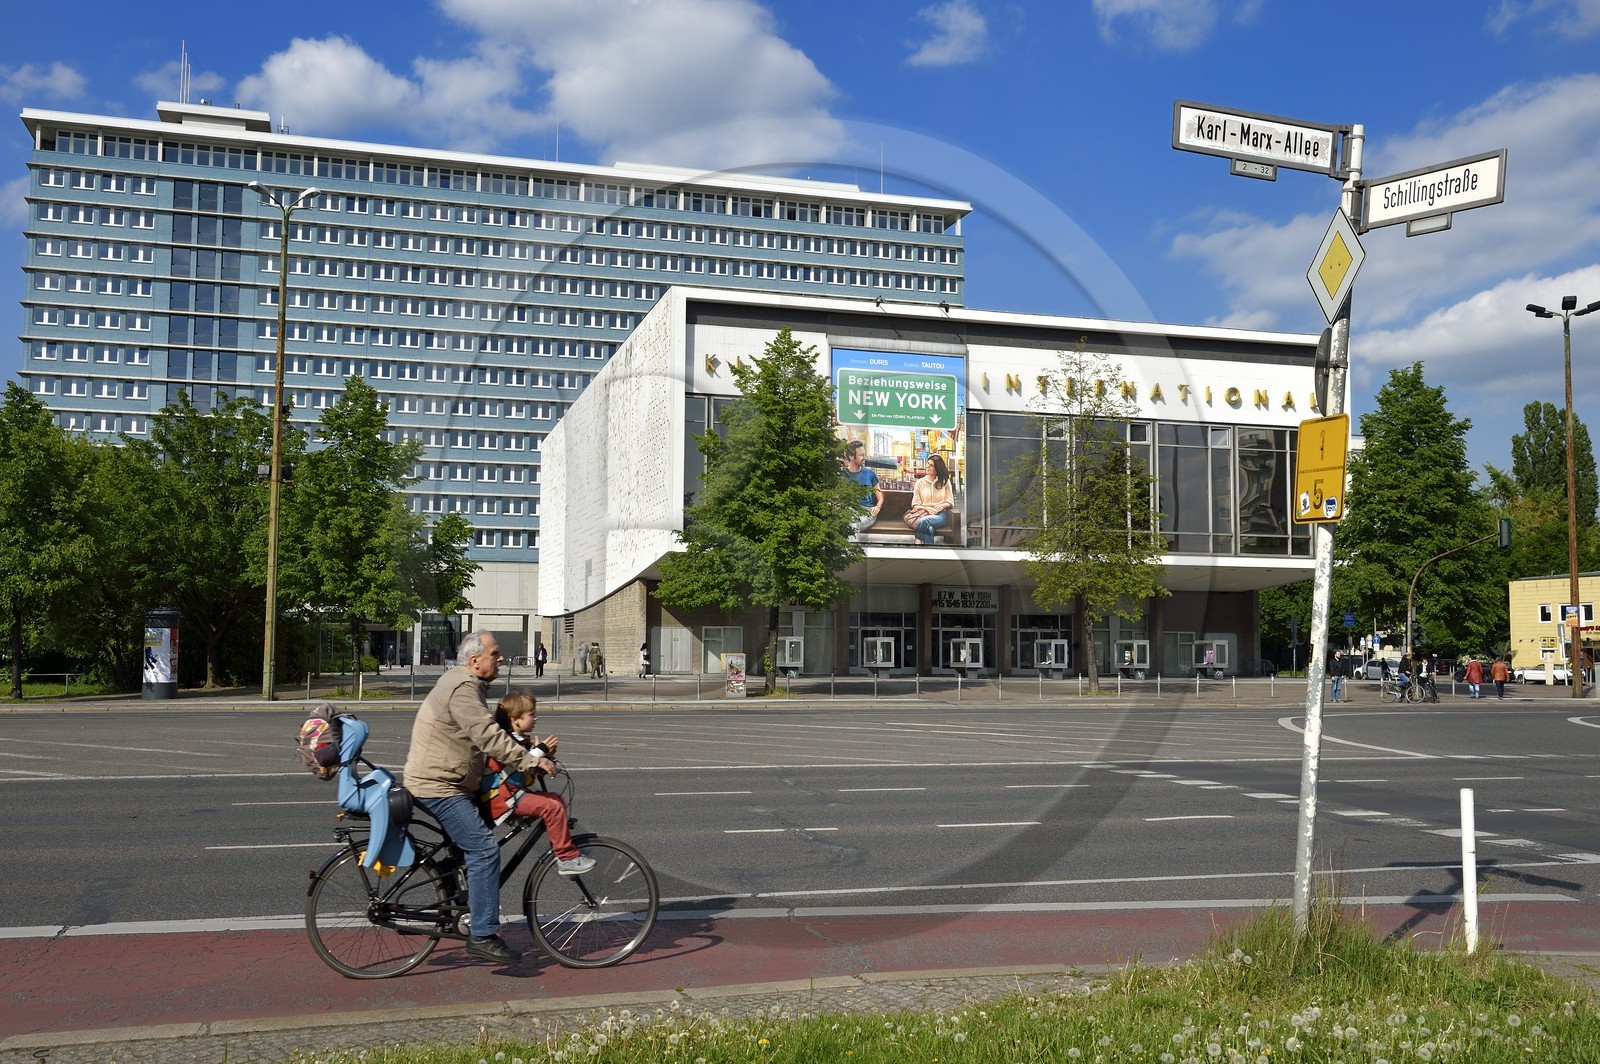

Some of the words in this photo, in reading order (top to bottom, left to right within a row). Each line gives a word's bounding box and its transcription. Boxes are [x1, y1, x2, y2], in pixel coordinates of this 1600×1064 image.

[1196, 115, 1320, 157] Karl-Marx-Allee
[1242, 162, 1248, 171] 2
[1260, 165, 1270, 175] 32
[1383, 168, 1479, 210] Schillingstraße
[869, 358, 889, 366] DURIS
[921, 361, 945, 370] TAUTOU
[848, 374, 947, 391] Beziehungsweise
[848, 389, 890, 407] NEW
[895, 391, 947, 410] YORK
[1313, 478, 1325, 510] 5
[960, 591, 975, 600] NEW
